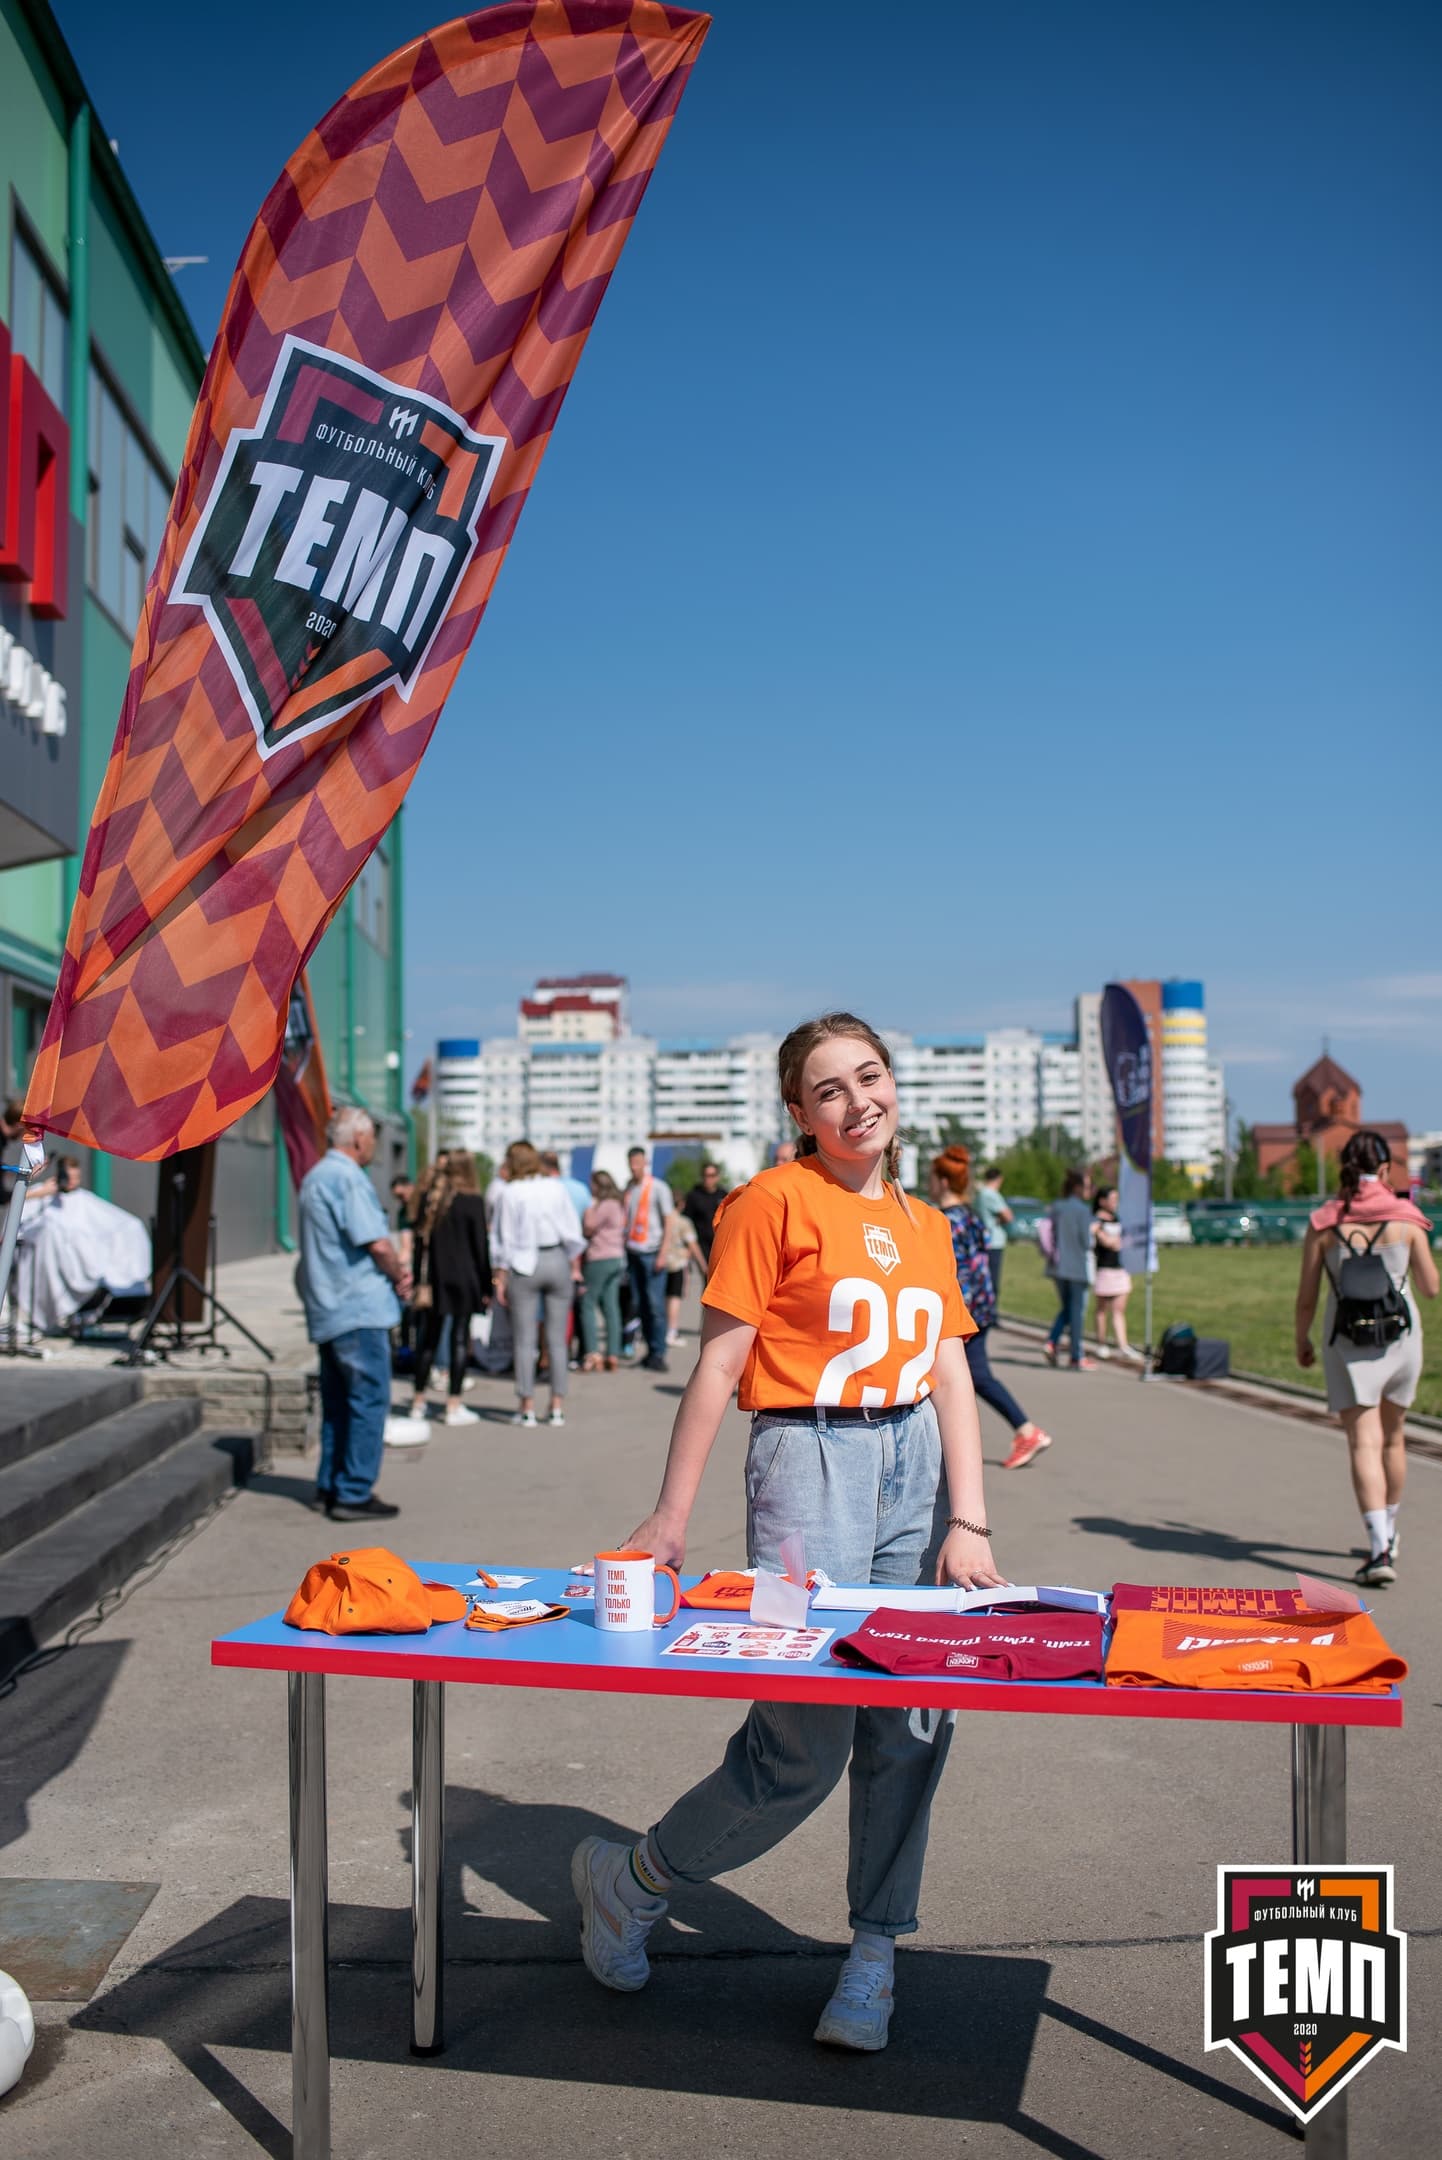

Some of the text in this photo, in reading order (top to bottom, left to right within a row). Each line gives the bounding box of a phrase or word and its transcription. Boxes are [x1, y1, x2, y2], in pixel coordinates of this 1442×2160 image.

[315, 423, 437, 501] ФУТБОЛЬНЫЙ КЛБ
[226, 461, 456, 653] ТЕМП
[305, 611, 338, 639] 2020
[867, 1238, 897, 1260] ТЕМП
[813, 1277, 943, 1408] 22
[604, 1597, 631, 1609] ТОЛЬКО
[607, 1612, 628, 1624] ТЕМП!
[639, 1854, 657, 1881] SHEIN
